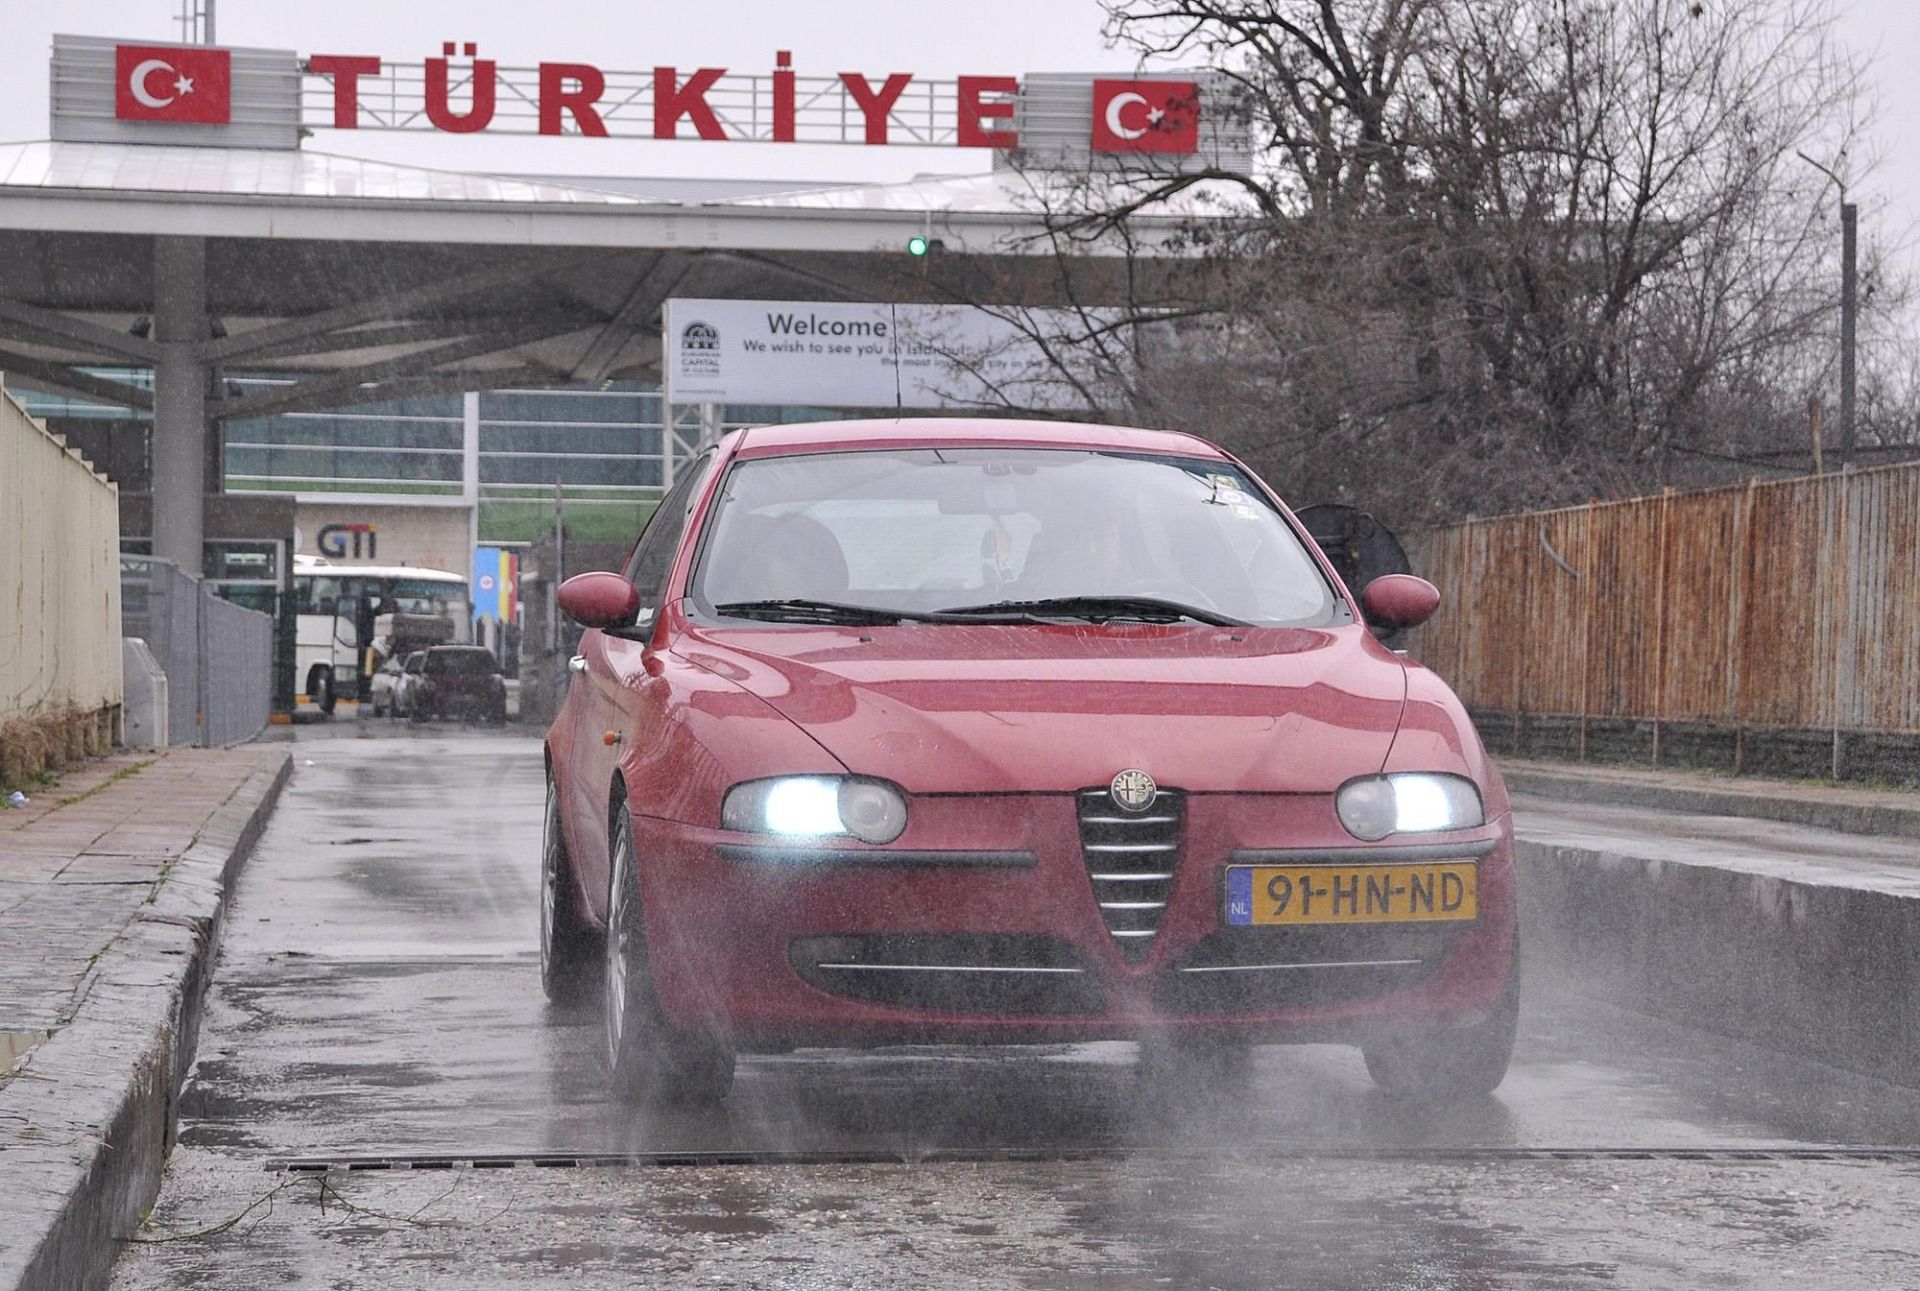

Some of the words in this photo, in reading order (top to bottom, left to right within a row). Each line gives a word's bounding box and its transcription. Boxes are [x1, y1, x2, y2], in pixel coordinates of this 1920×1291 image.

[309, 41, 1019, 148] TÜRKİYE
[767, 313, 887, 337] Welcome
[743, 340, 766, 352] We
[771, 339, 804, 353] wish
[809, 342, 824, 353] to
[828, 344, 852, 353] see
[857, 343, 883, 357] you
[888, 338, 902, 354] in
[317, 523, 377, 559] GTI
[1231, 902, 1248, 915] NL
[1267, 871, 1464, 916] 91-HN-ND
